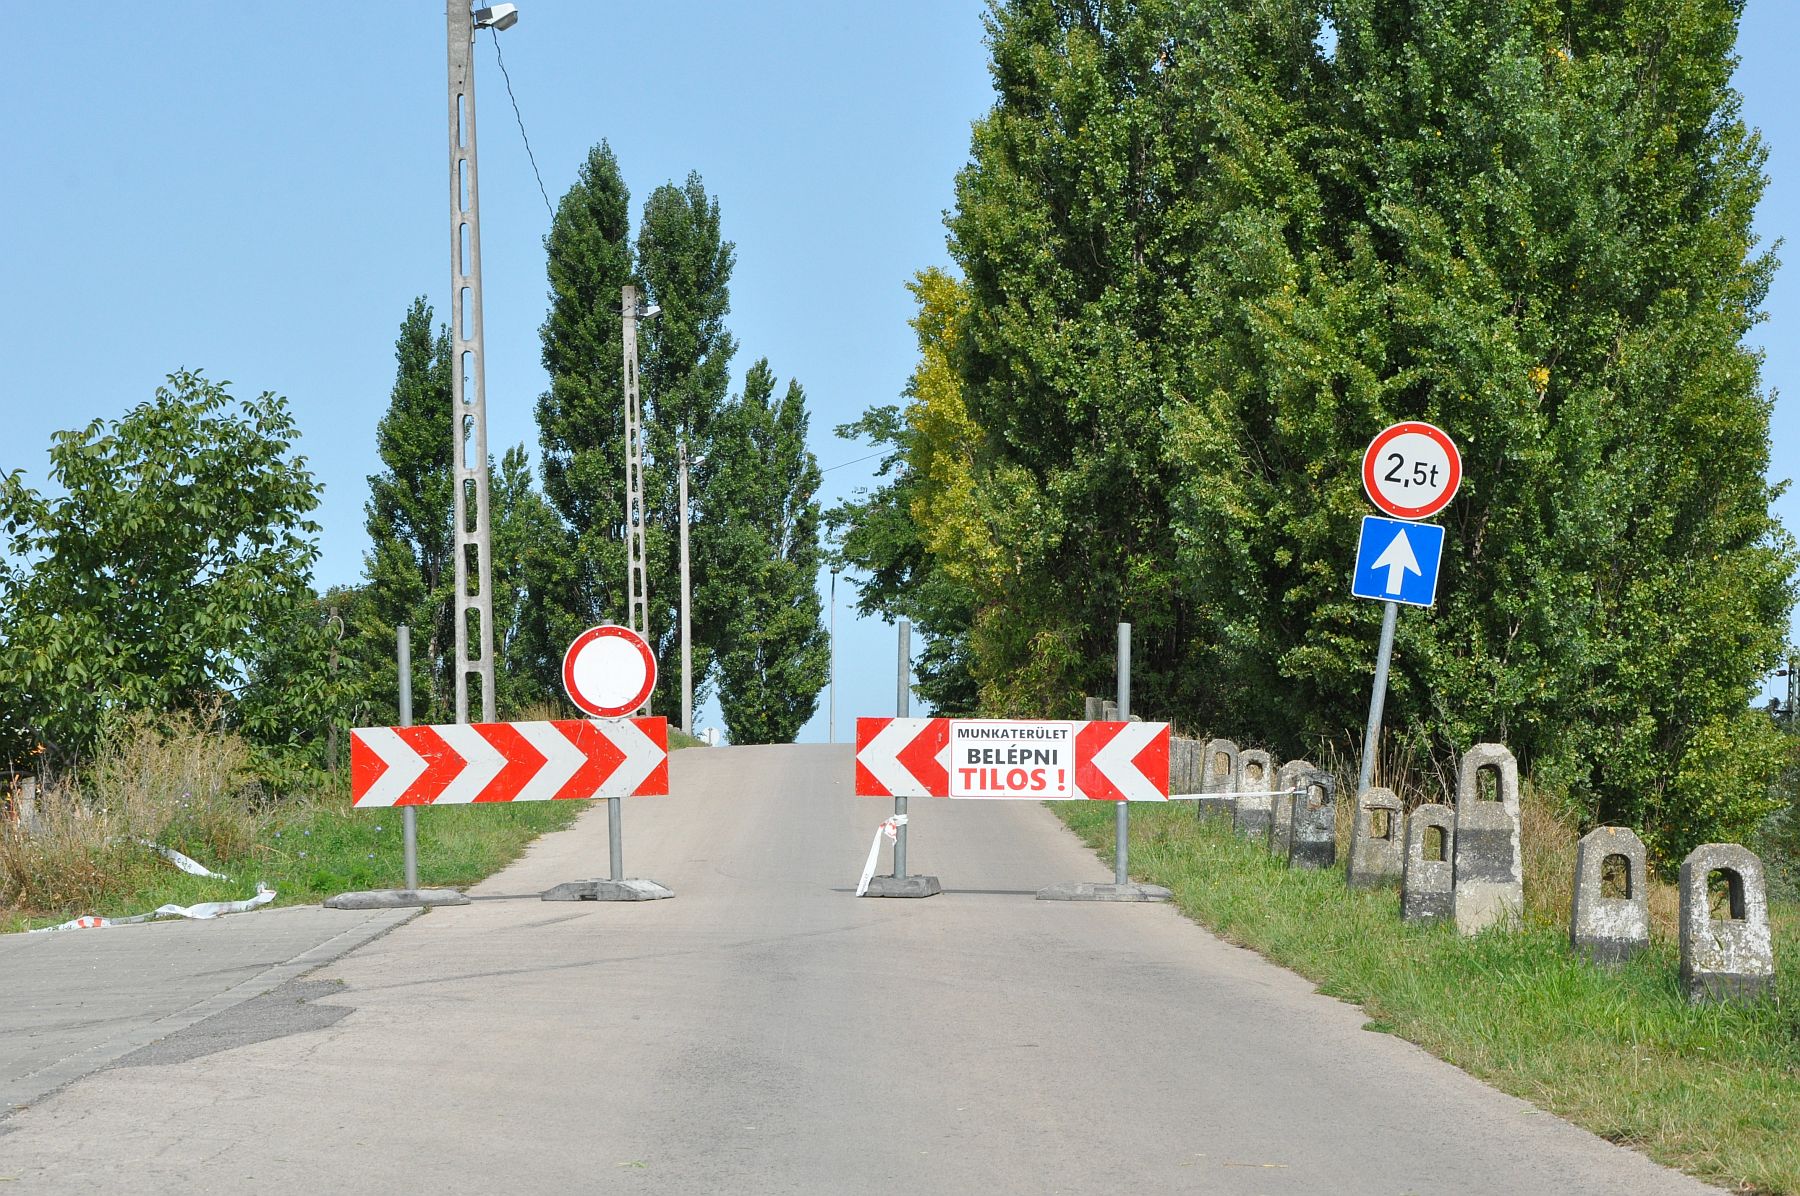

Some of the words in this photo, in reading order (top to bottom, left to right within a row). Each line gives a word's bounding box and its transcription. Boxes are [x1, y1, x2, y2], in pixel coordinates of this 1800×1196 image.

[1384, 453, 1439, 488] 2,5t
[957, 726, 1068, 739] MUNKATERÜLET
[967, 744, 1058, 765] BELÉPNI
[958, 768, 1047, 791] TILOS
